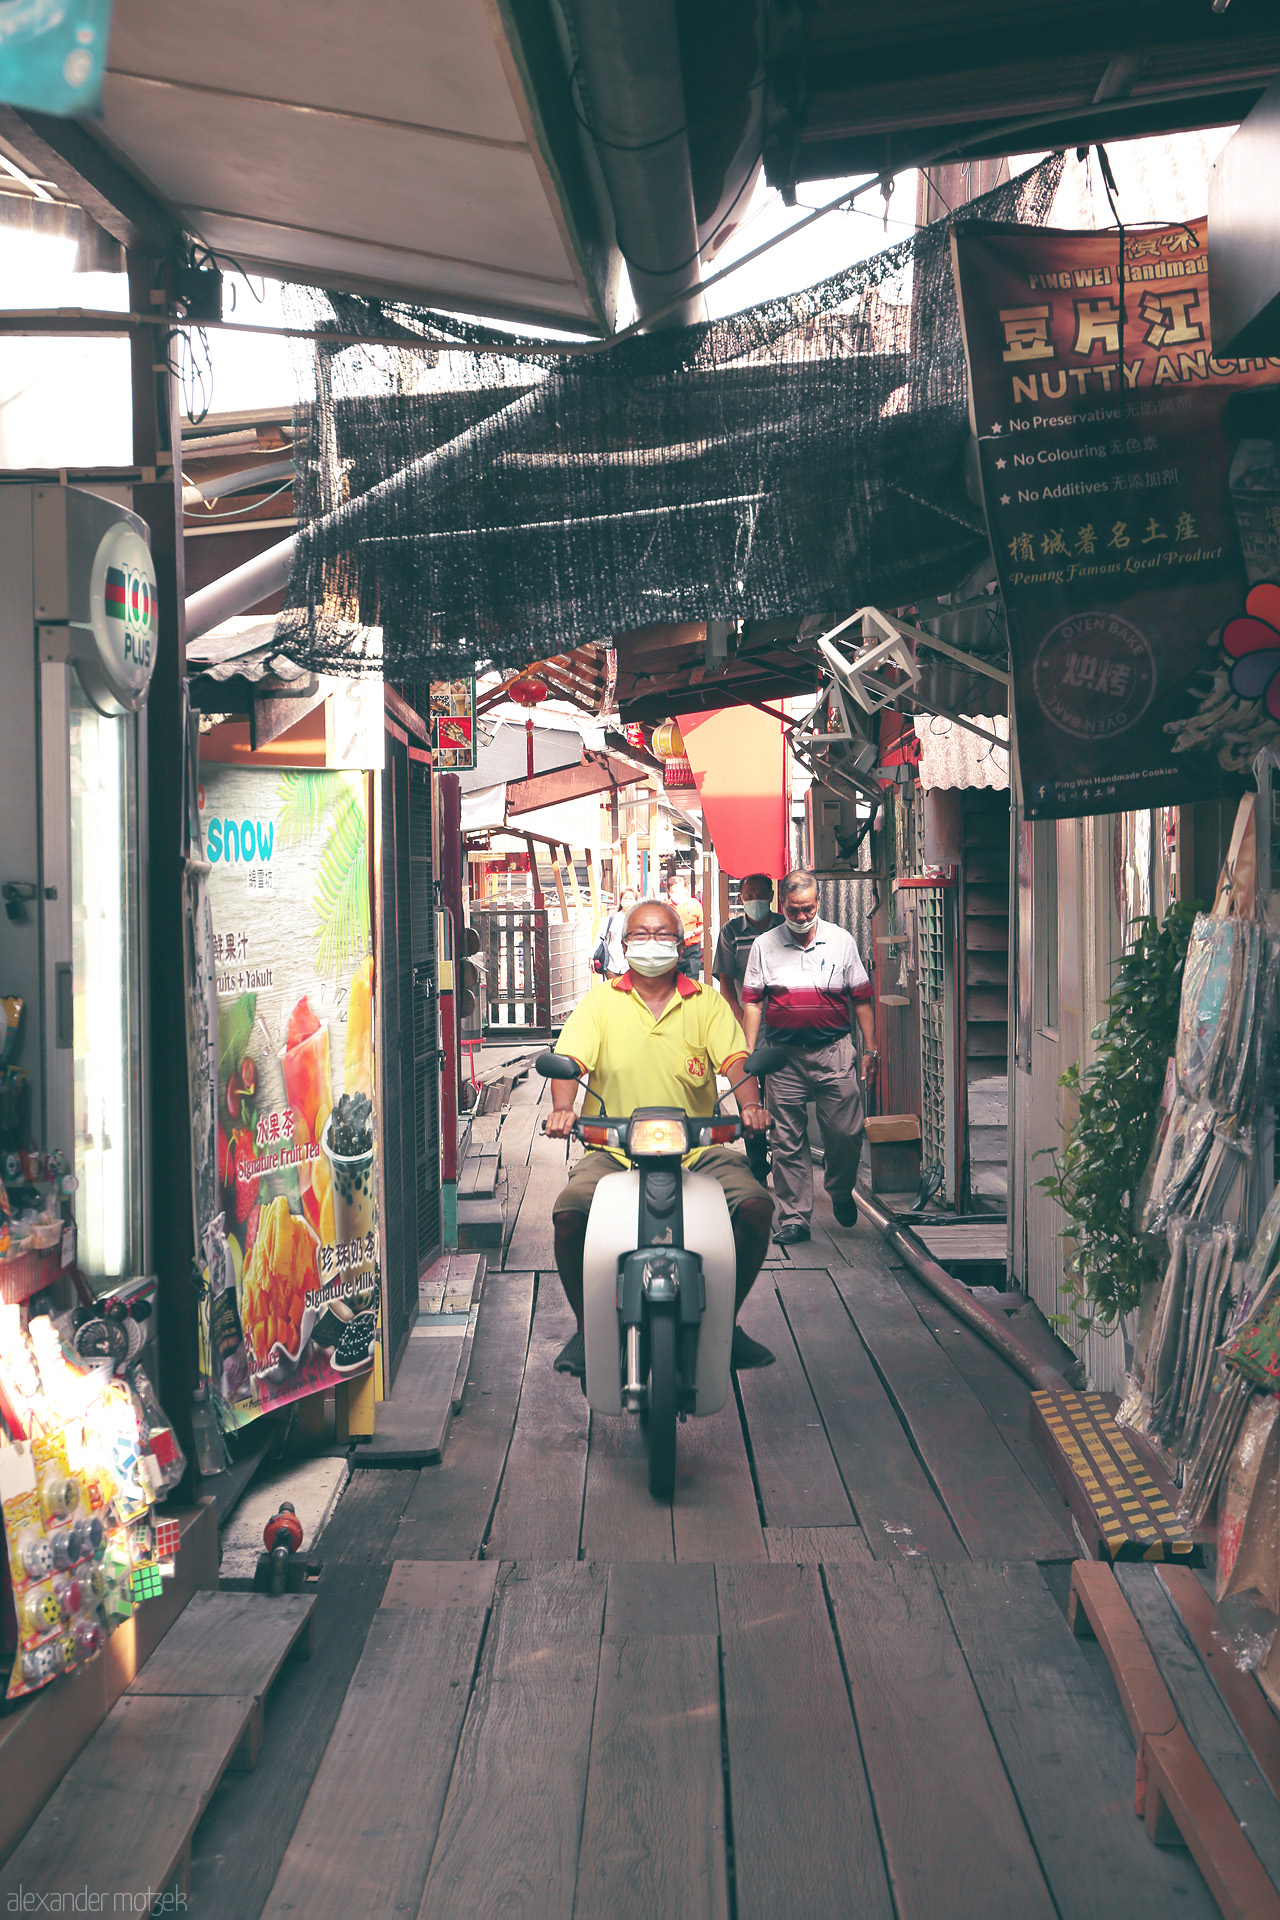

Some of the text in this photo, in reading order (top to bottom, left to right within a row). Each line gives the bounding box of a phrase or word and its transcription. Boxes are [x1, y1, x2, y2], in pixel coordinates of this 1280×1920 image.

[1029, 256, 1208, 290] PING WEI Handmad
[999, 291, 1200, 362] 豆片江
[1012, 360, 1143, 403] NUTTY
[1009, 419, 1030, 432] No
[1033, 408, 1121, 430] Preservative
[1014, 434, 1158, 467] No Colouring 无色素
[1018, 467, 1179, 503] No Additives 无添加剂
[1009, 546, 1222, 586] Penang Famous Local Product
[121, 562, 152, 636] 100
[124, 632, 151, 668] PLUS
[1062, 618, 1145, 656] OVEN BAKE
[1062, 652, 1131, 697] 烘烤
[1046, 695, 1127, 732] OVEN BAKE
[1054, 767, 1178, 790] Ping Wei Handmade Cookies
[207, 817, 274, 863] snow
[238, 972, 244, 988] +
[246, 968, 273, 989] Yakult
[257, 1109, 295, 1144] 水果茶
[237, 1142, 320, 1181] Signature Fruit Tea
[321, 1231, 375, 1272] 珍珠奶茶
[305, 1270, 374, 1309] Signature Milk
